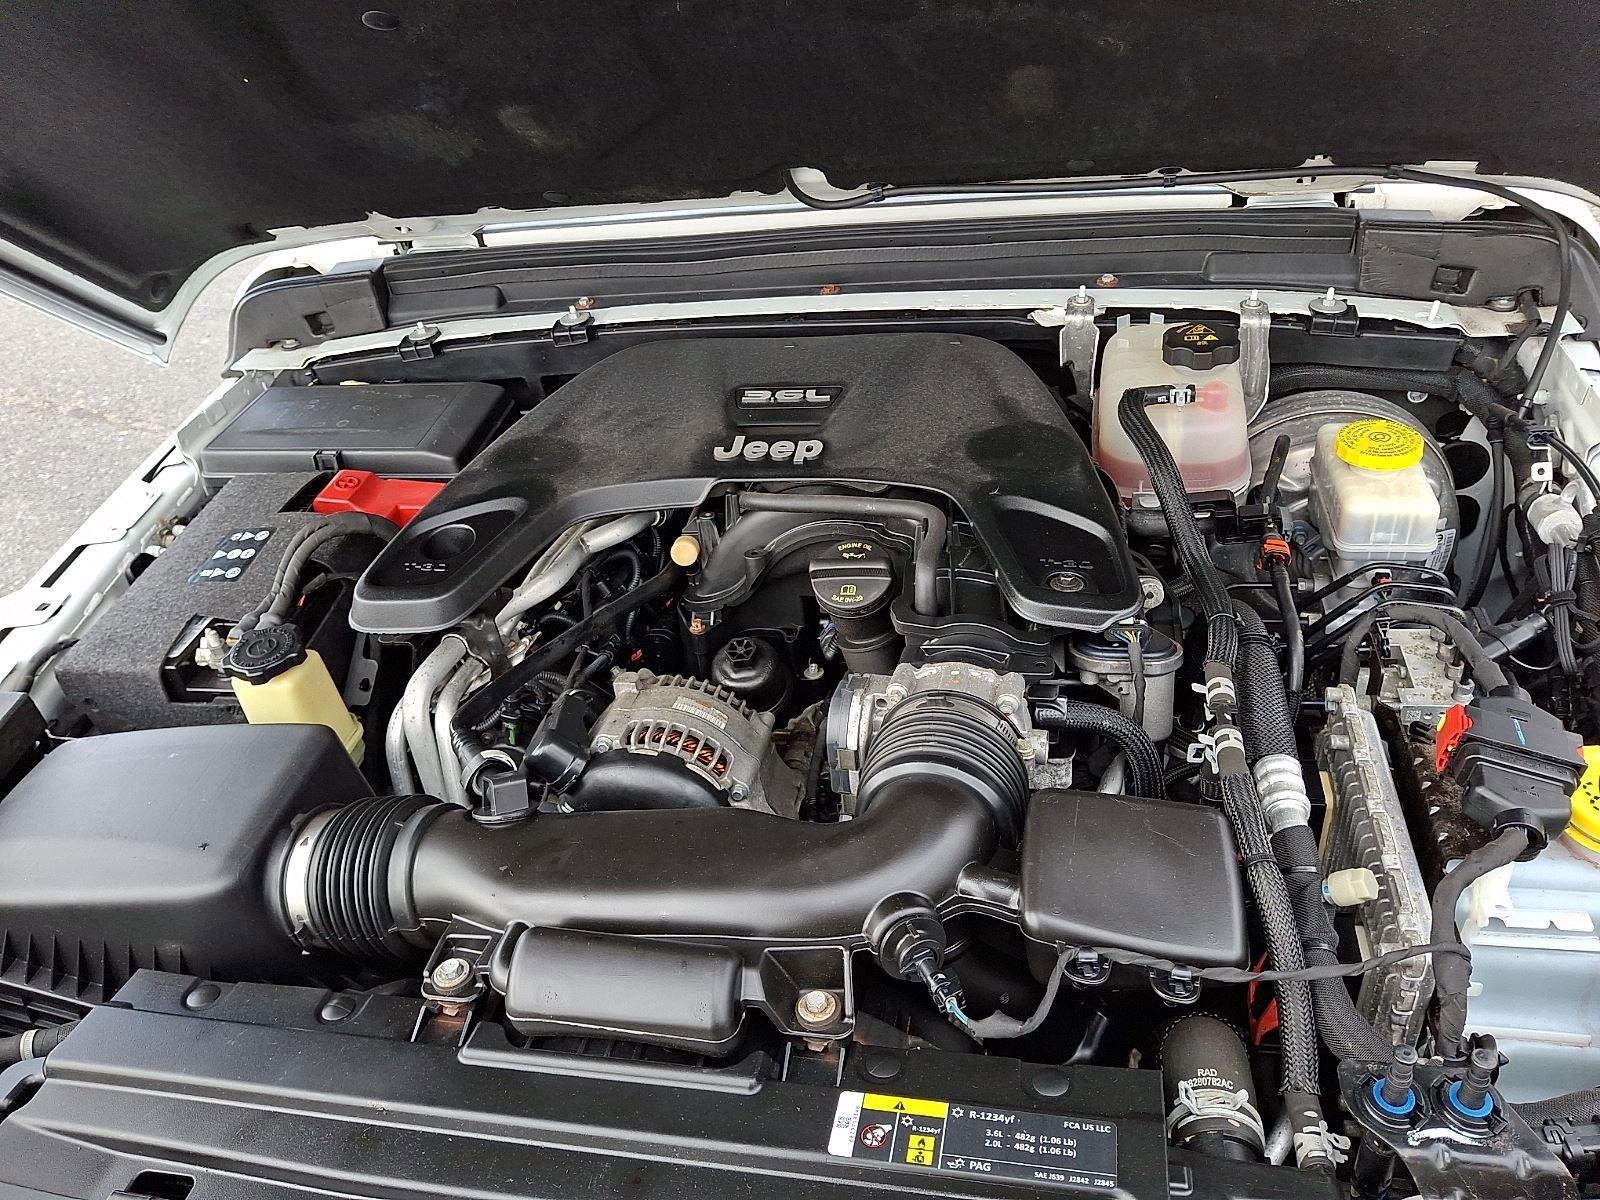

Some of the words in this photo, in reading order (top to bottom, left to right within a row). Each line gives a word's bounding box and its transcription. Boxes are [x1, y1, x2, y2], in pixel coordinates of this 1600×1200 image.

[742, 390, 831, 403] 3.6L
[713, 435, 824, 464] Jeep
[837, 542, 862, 551] ENGINE
[862, 543, 873, 551] OIL
[831, 594, 844, 603] SAE
[844, 595, 864, 603] 0W-20
[1197, 1068, 1218, 1077] RAD
[1184, 1077, 1234, 1090] 8280782AC
[969, 1110, 1016, 1125] R-1234yf
[911, 1124, 942, 1135] R-1234yf
[1063, 1121, 1081, 1130] FCA
[1082, 1123, 1095, 1131] US
[1096, 1124, 1112, 1133] LLC
[985, 1129, 1004, 1138] 3.6L
[1014, 1132, 1036, 1143] 482g
[1039, 1134, 1061, 1145] (1.06
[1063, 1138, 1077, 1148] Lb)
[984, 1139, 1003, 1148] 2.0L
[1013, 1142, 1036, 1153] 482g
[1038, 1145, 1061, 1155] (1.06
[1062, 1148, 1077, 1158] Lb)
[969, 1160, 992, 1172] PAG
[1034, 1171, 1048, 1180] SAE
[1048, 1172, 1065, 1181] J639
[1069, 1175, 1090, 1184] J2842
[1093, 1179, 1115, 1188] J2845
